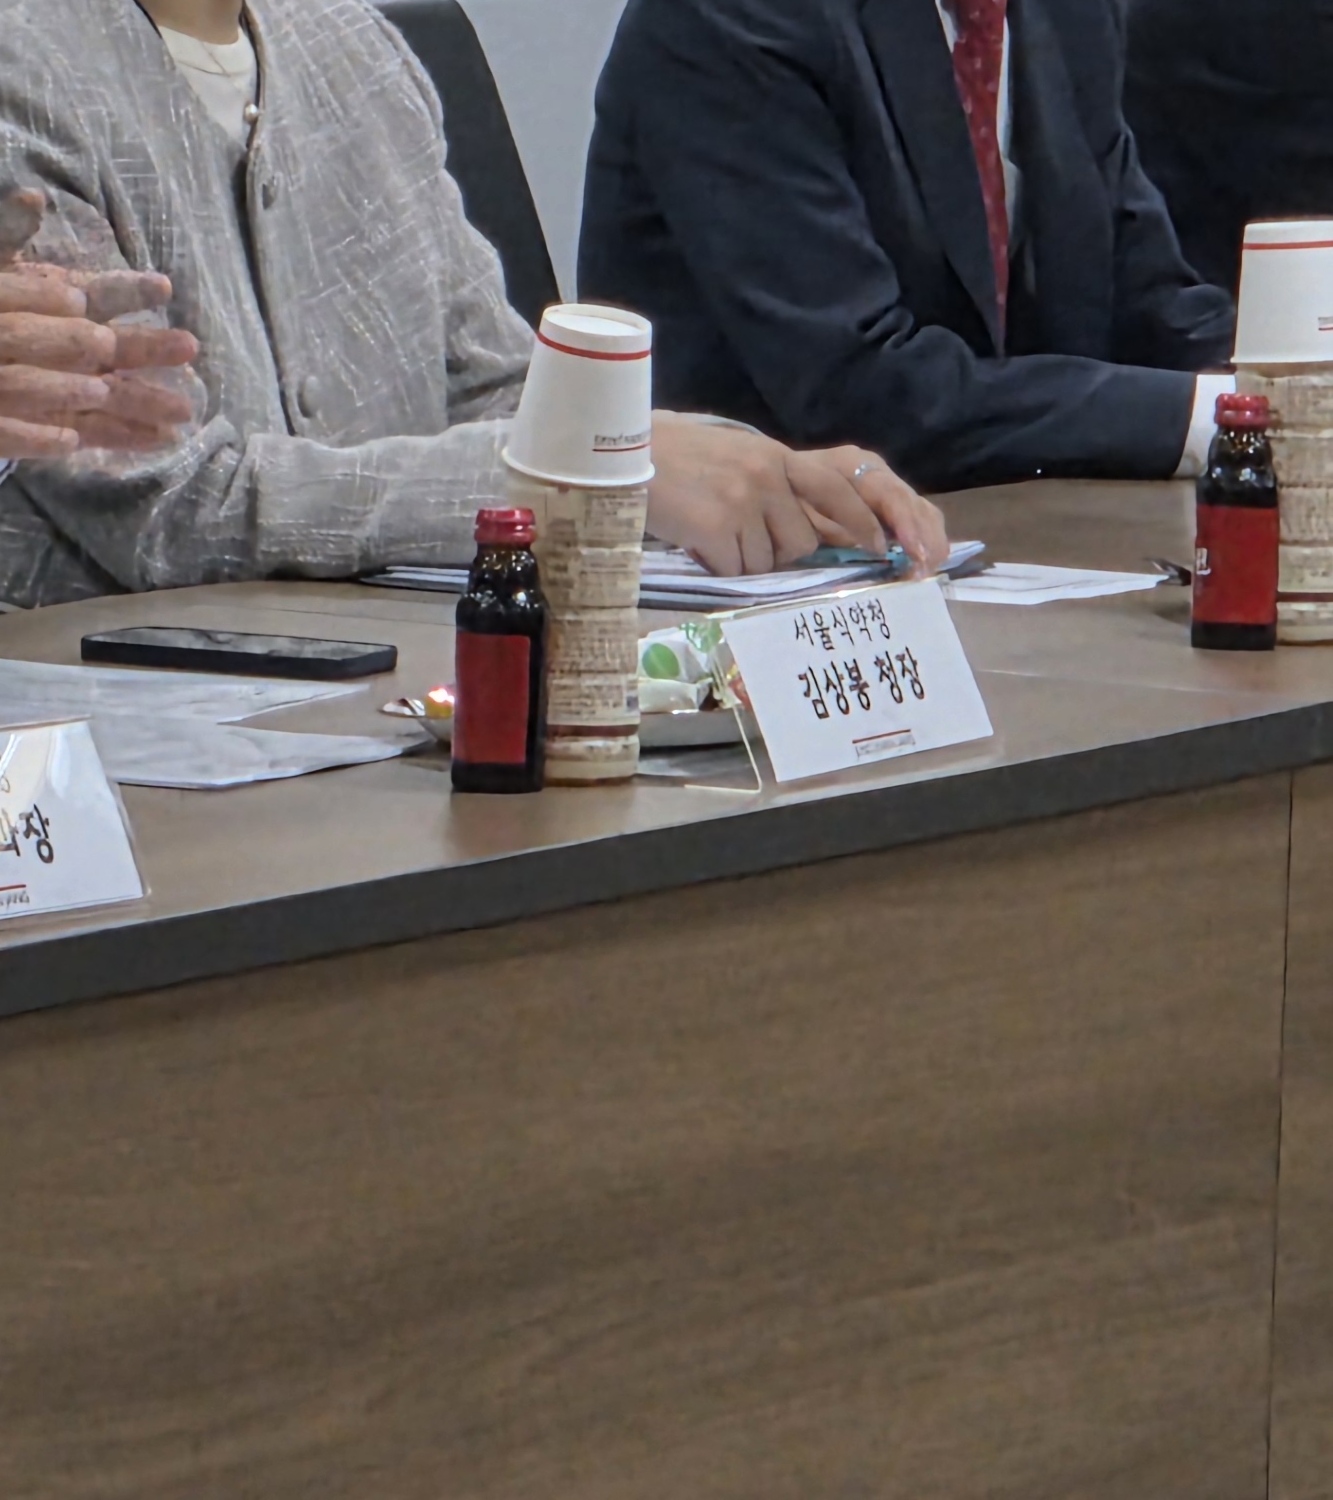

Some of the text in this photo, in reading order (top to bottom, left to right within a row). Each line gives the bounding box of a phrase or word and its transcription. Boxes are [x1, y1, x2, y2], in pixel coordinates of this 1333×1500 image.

[794, 598, 891, 650] 서울식약청
[797, 647, 925, 719] 김상봉 청장
